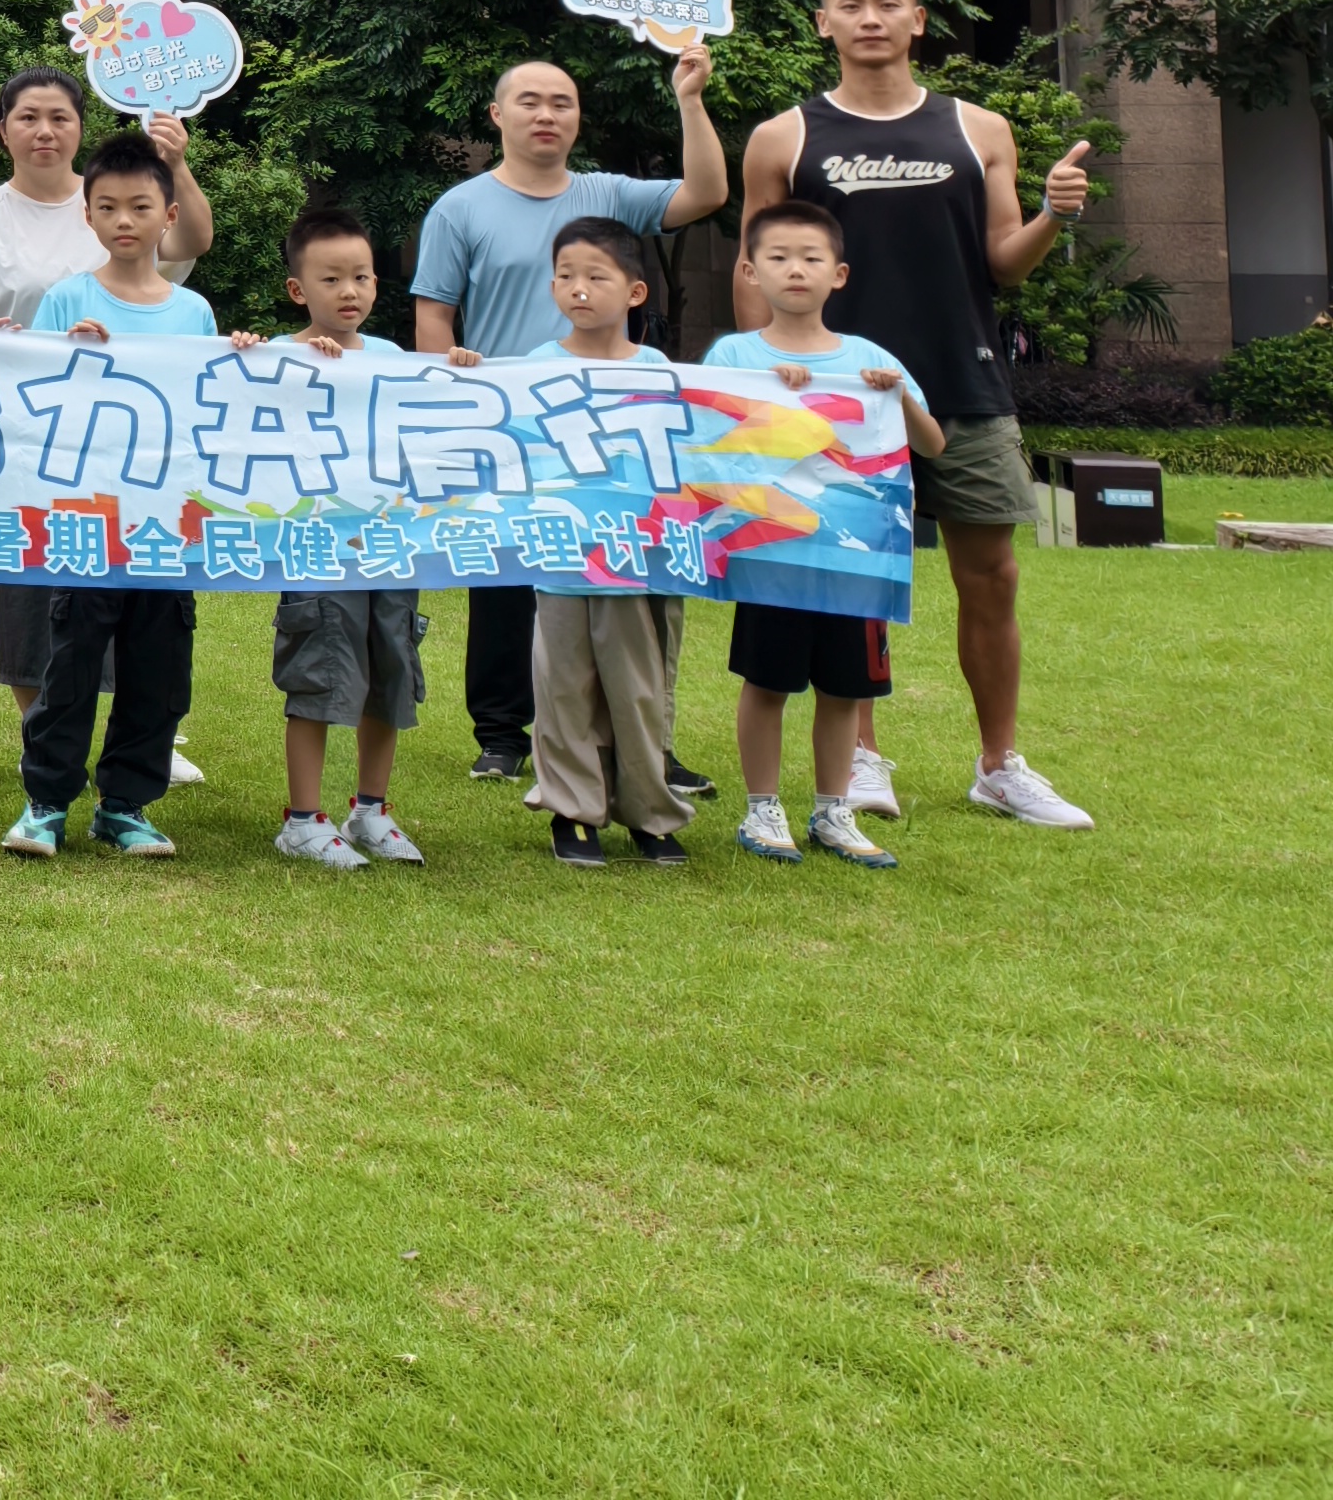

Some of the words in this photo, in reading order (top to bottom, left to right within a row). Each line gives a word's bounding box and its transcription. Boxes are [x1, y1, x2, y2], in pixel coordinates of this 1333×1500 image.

[102, 40, 188, 80] 跑过晨光
[142, 53, 226, 92] 留下成长
[821, 154, 955, 183] Wabrave
